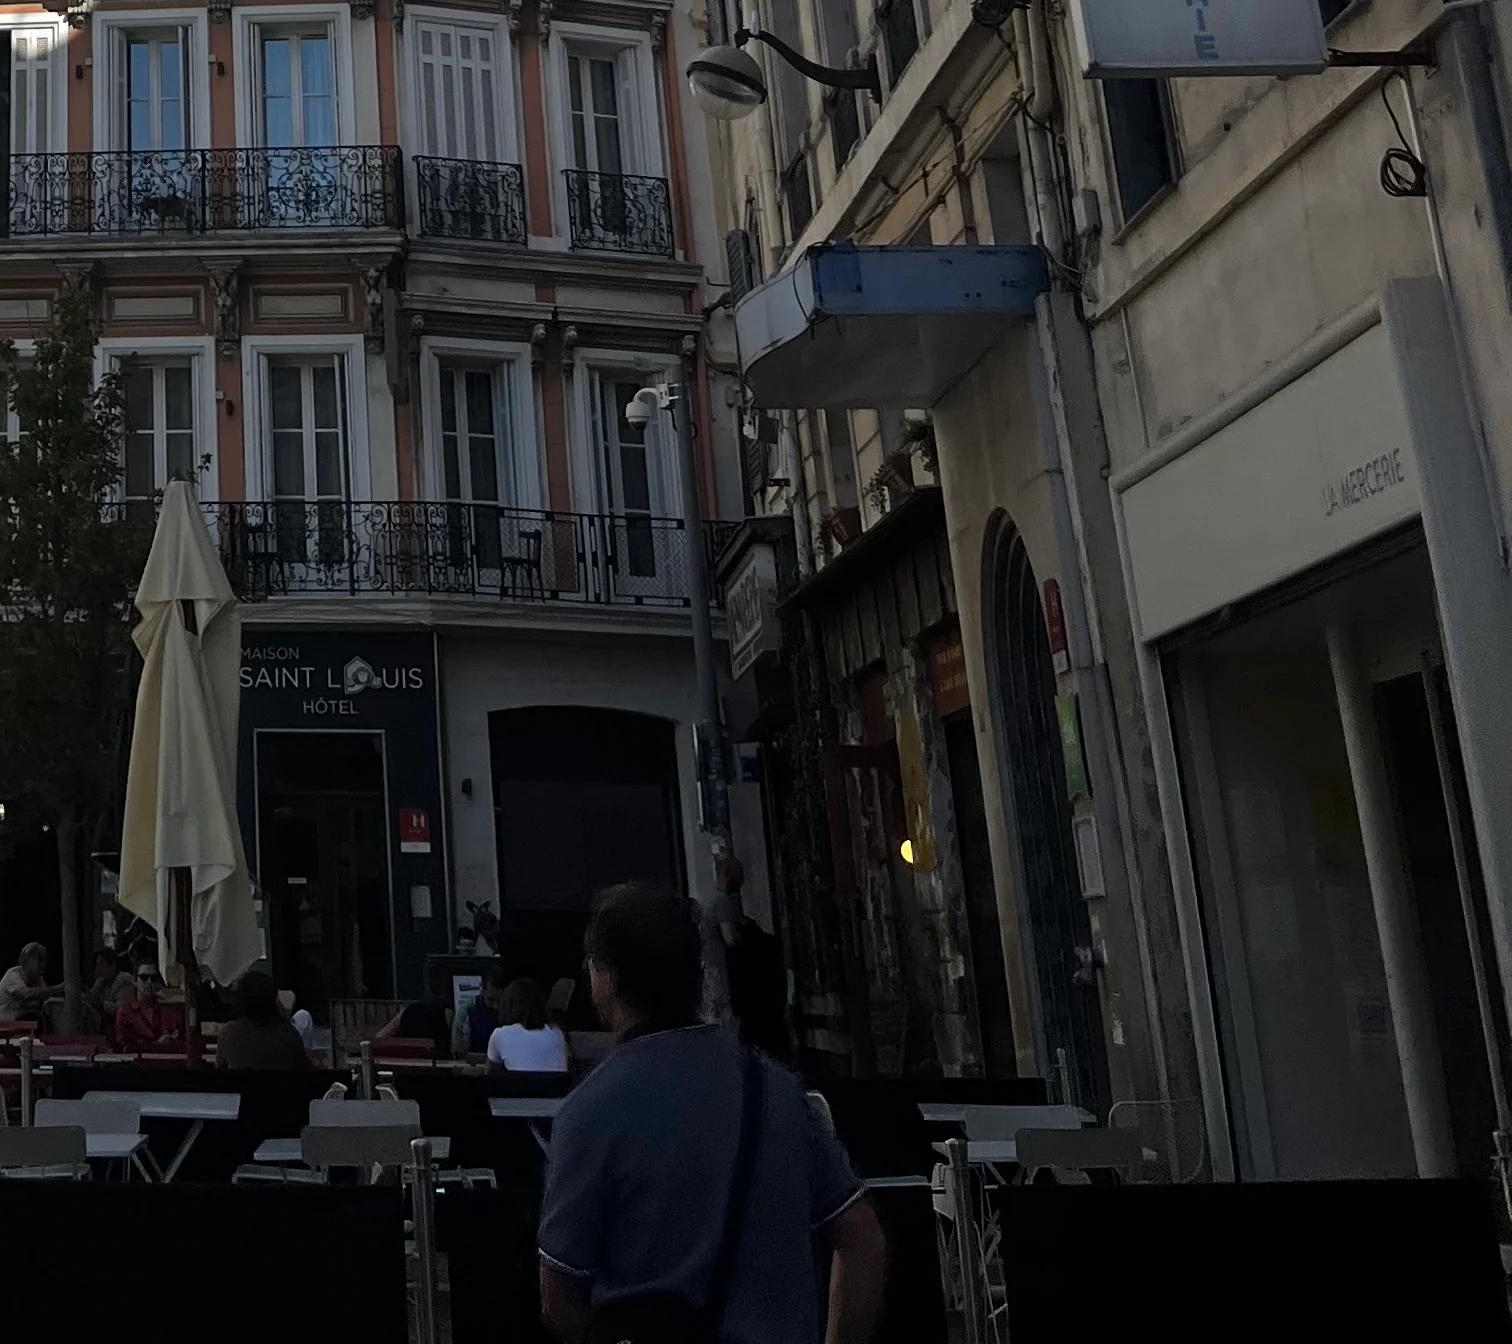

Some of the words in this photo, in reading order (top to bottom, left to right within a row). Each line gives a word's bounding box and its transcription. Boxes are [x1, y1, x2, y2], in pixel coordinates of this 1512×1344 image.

[1341, 447, 1405, 505] MERCERIE
[240, 647, 300, 661] MAISON
[239, 667, 316, 689] SAINT
